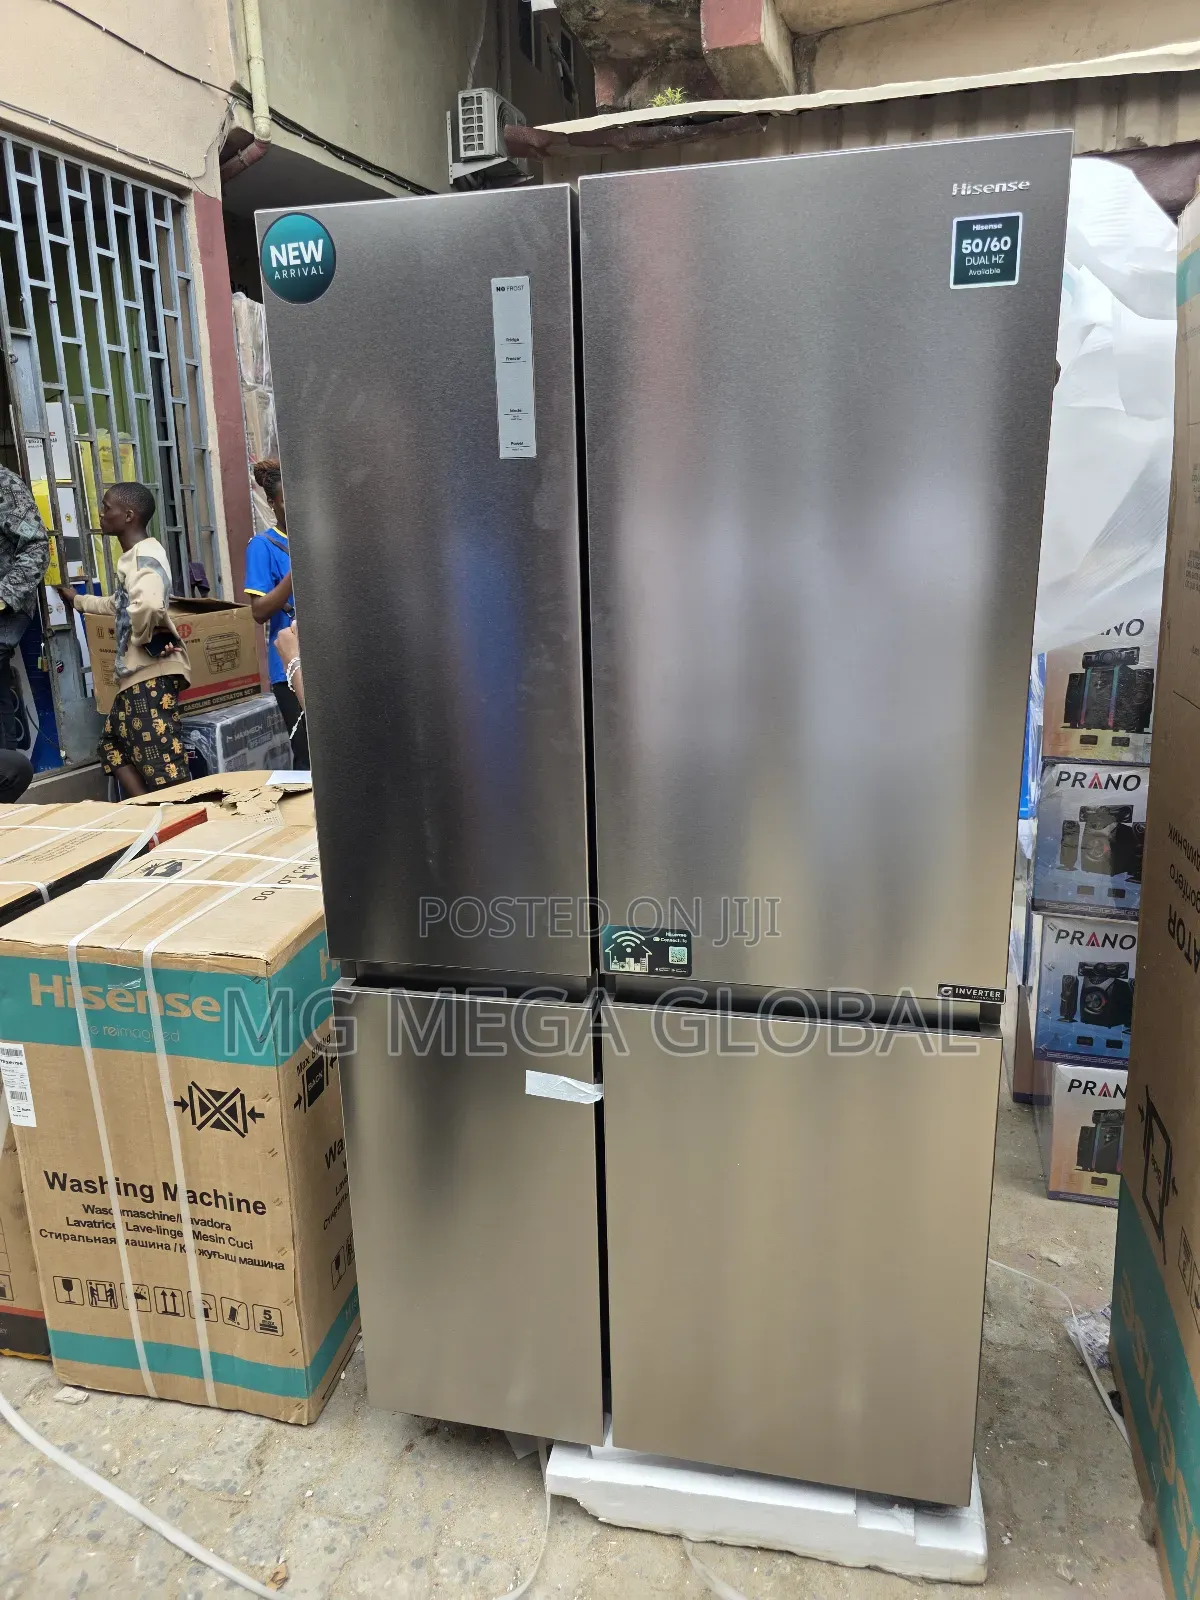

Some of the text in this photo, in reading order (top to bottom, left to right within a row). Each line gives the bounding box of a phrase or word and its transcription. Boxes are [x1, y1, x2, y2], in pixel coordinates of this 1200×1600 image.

[951, 180, 1031, 196] Hisense
[972, 223, 1003, 231] Hisense
[269, 239, 324, 268] NEW
[961, 236, 1012, 254] 50/60
[965, 254, 1005, 266] DUAL HZ
[274, 266, 325, 280] ARRIVAL
[968, 267, 1001, 276] Available
[506, 284, 525, 292] FROST
[1055, 770, 1142, 792] PRANO
[251, 890, 276, 901] DO
[270, 874, 297, 890] OT
[1054, 928, 1137, 950] PRANO
[28, 972, 222, 1023] Hisense
[955, 987, 1001, 998] INVERTER
[103, 1024, 181, 1044] reimagied
[43, 1169, 267, 1216] Washing Machine
[191, 1229, 226, 1245] Mesin
[227, 1236, 254, 1250] Cuci
[39, 1228, 117, 1245] Стиральная
[238, 1255, 286, 1271] машина
[263, 1309, 273, 1321] 5
